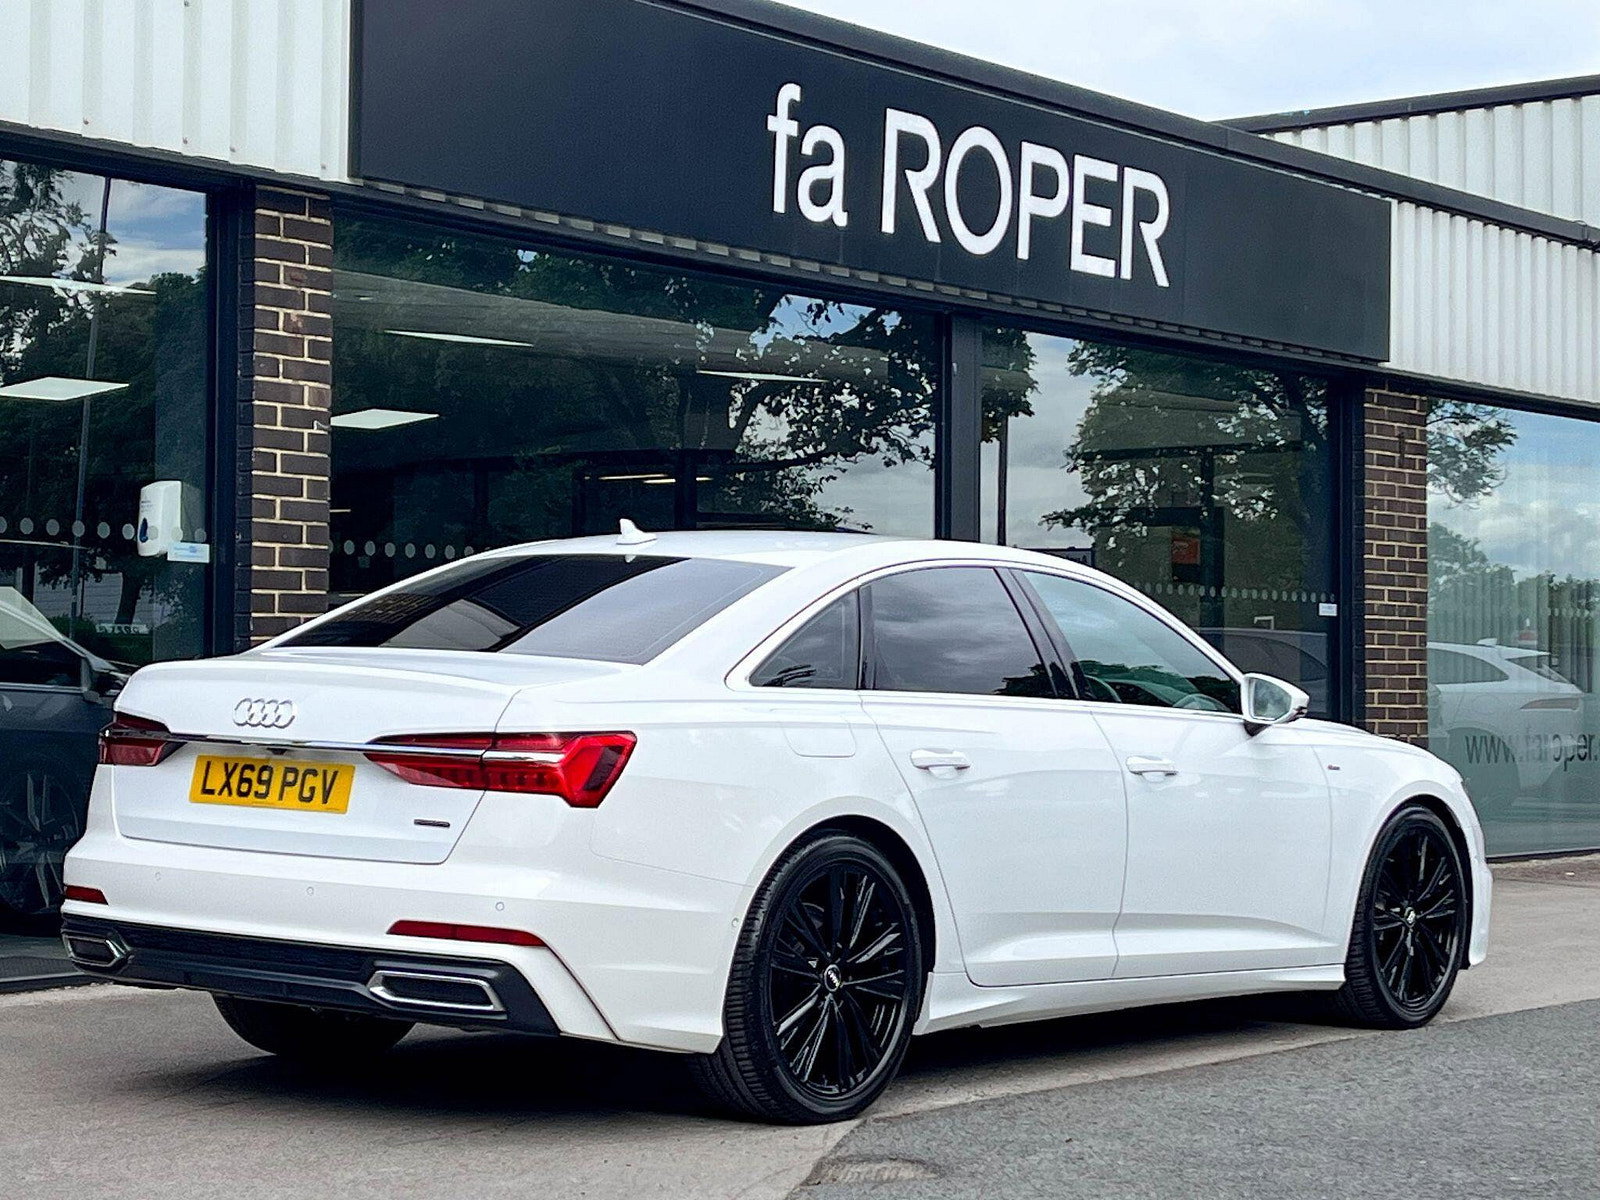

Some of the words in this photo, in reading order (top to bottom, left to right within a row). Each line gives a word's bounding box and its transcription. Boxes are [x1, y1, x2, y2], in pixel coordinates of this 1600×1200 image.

[767, 83, 848, 227] fa
[881, 108, 1170, 287] ROPER
[1465, 724, 1600, 772] www.faroper.
[200, 760, 274, 799] LX69
[278, 766, 339, 804] PGV
